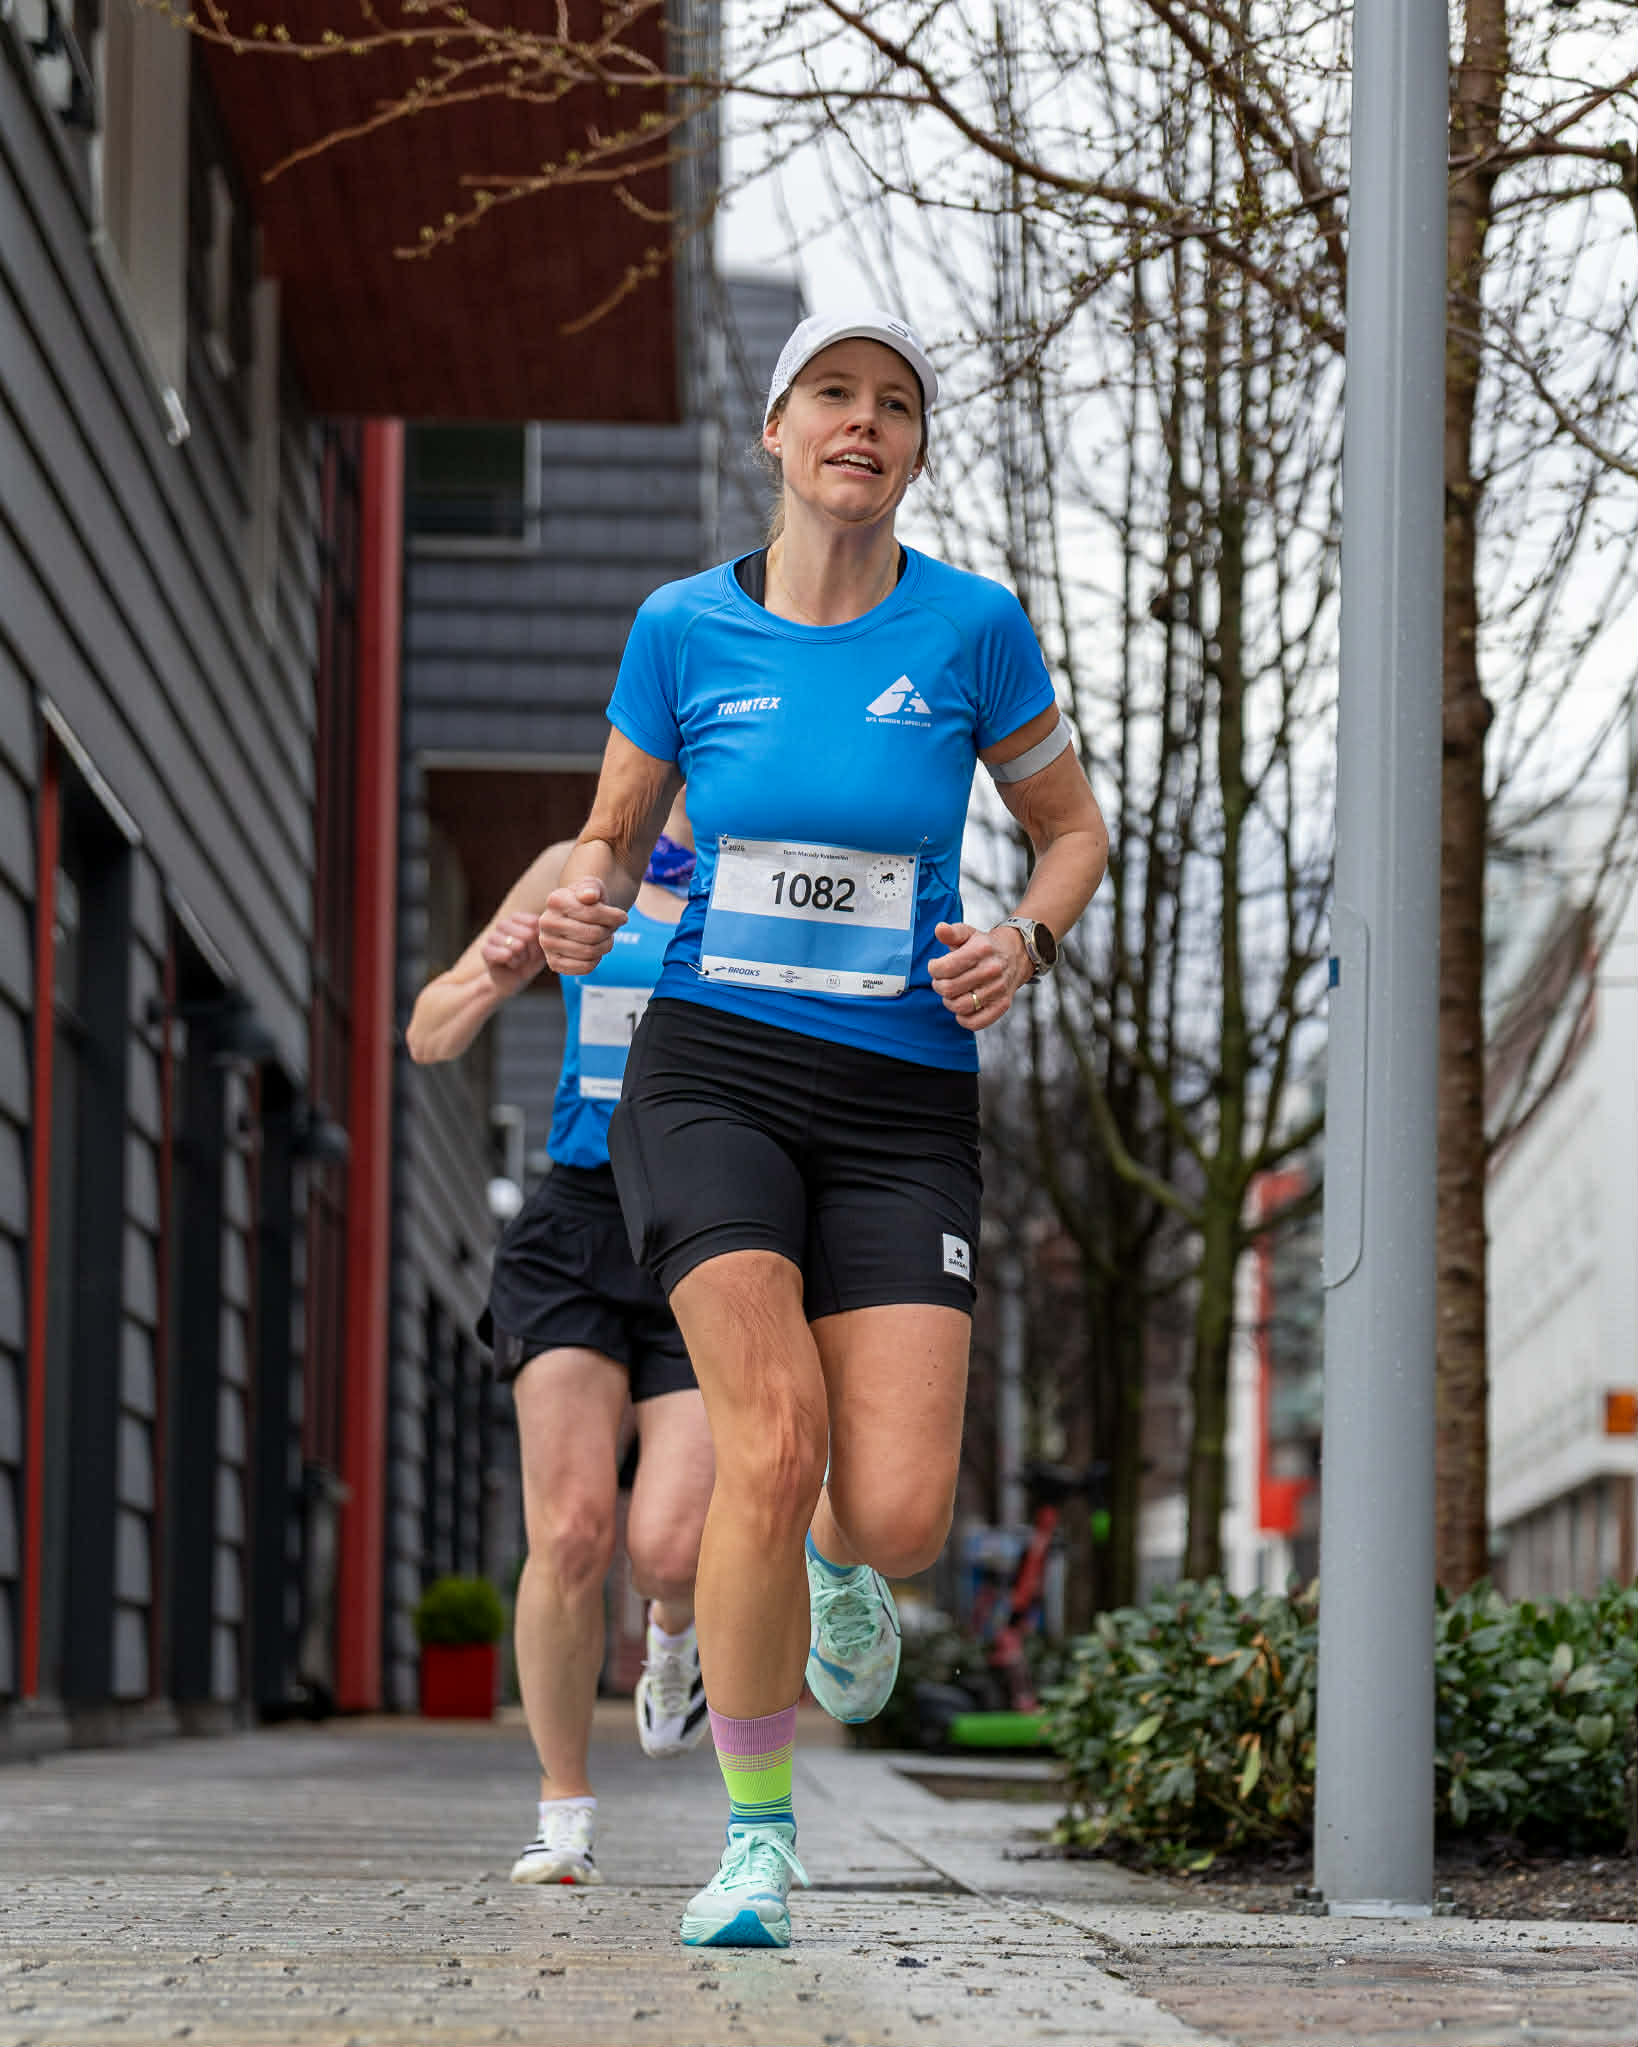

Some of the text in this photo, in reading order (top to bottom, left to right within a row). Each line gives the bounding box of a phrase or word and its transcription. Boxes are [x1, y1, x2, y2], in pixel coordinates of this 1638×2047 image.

[717, 697, 781, 716] TRIMTEX
[771, 871, 856, 912] 1082
[728, 967, 761, 977] BROOKS
